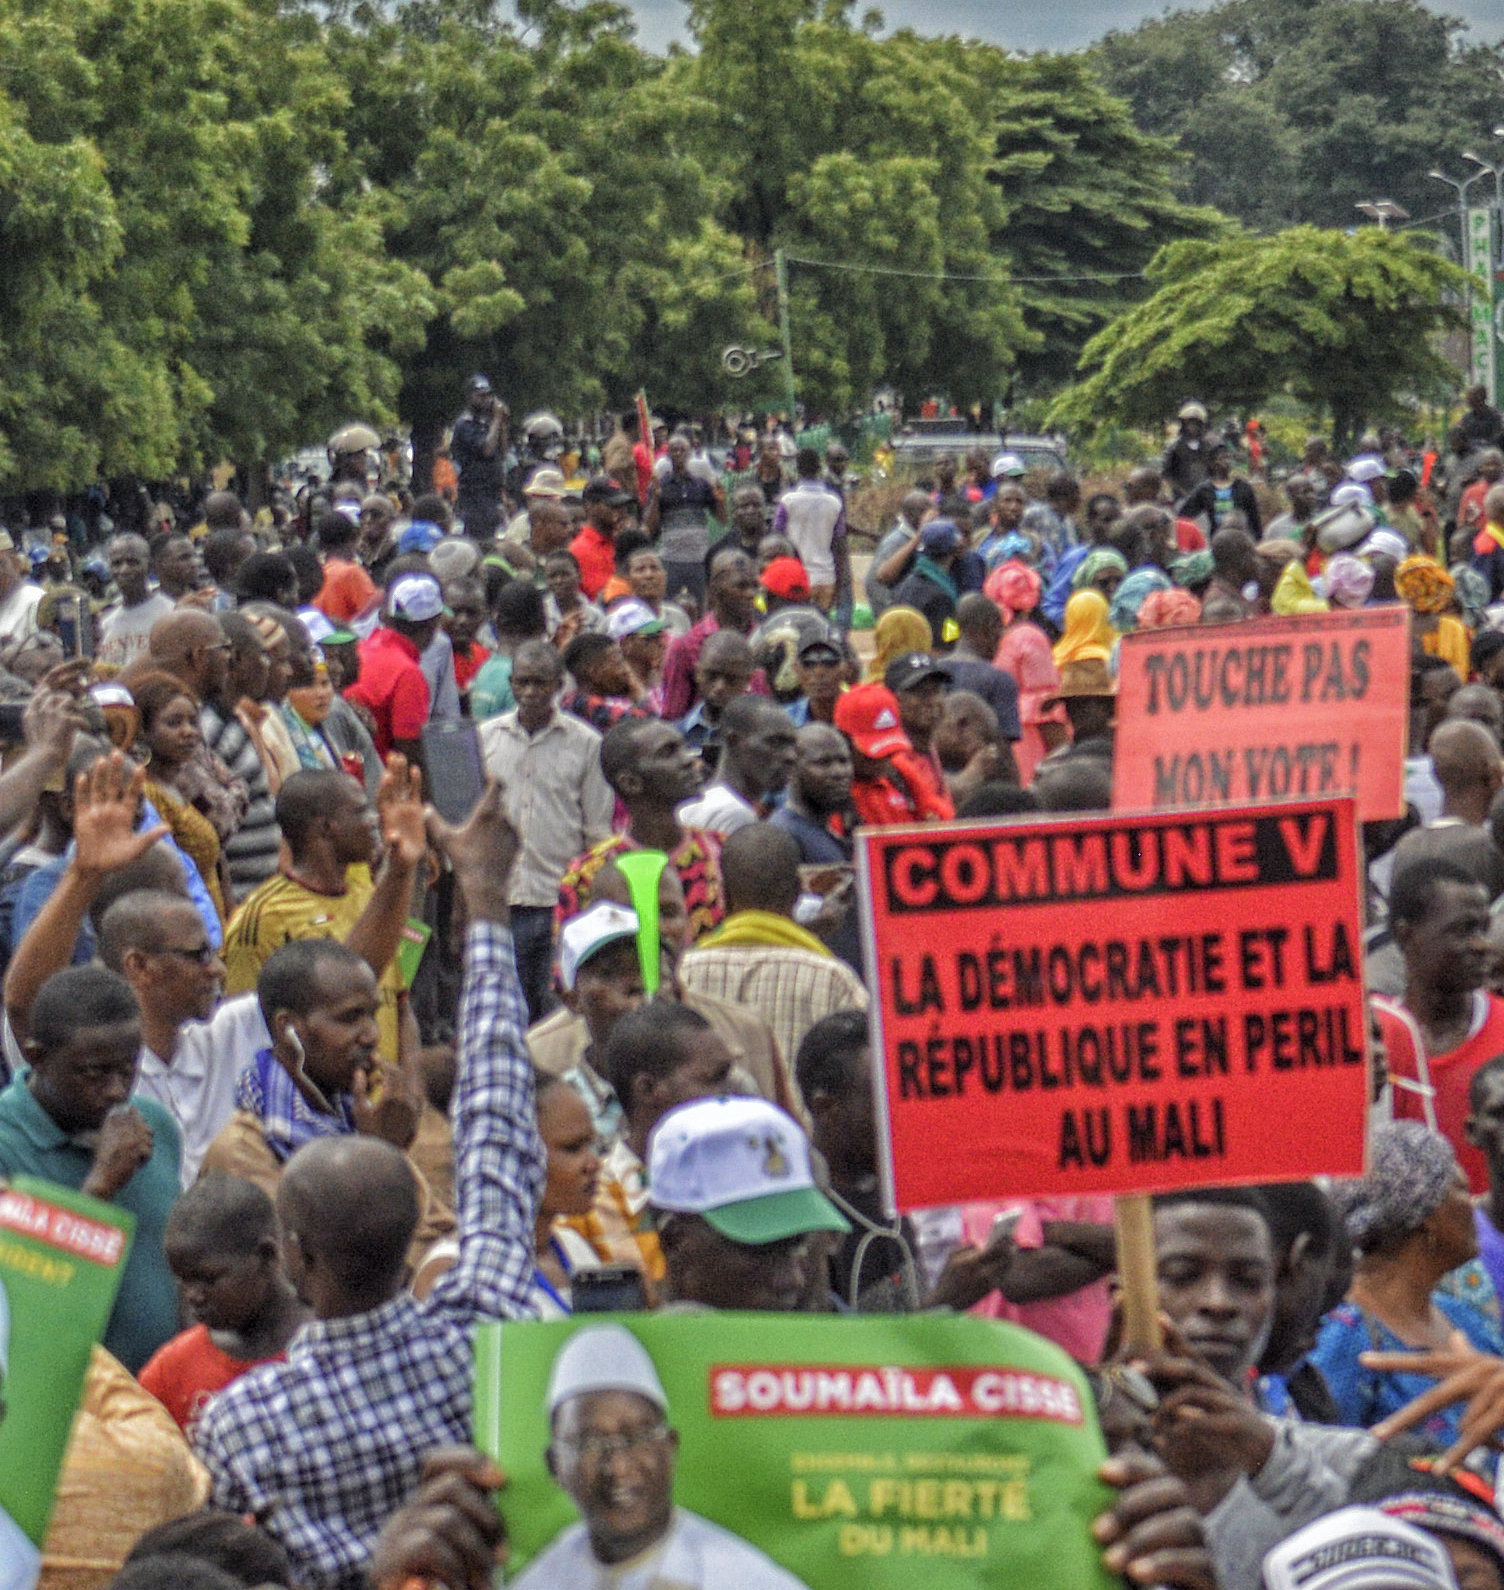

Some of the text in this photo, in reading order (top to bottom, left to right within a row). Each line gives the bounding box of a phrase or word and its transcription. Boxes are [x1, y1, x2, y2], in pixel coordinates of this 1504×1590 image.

[1144, 639, 1371, 715] TOUCHE PAS
[1153, 747, 1234, 803] MON
[1245, 741, 1341, 798] VOTE
[894, 813, 1329, 908] COMMUNE V
[894, 919, 1358, 1018] LA DÉMOCRATIE ET LA
[897, 1003, 1365, 1098] RÉPUBLIQUE EN PERIL
[1059, 1098, 1225, 1169] AU MALI
[714, 1365, 964, 1412] SOUMAÏLA
[792, 1466, 1032, 1523] LA FIERTÉ
[839, 1525, 989, 1559] DU MALI
